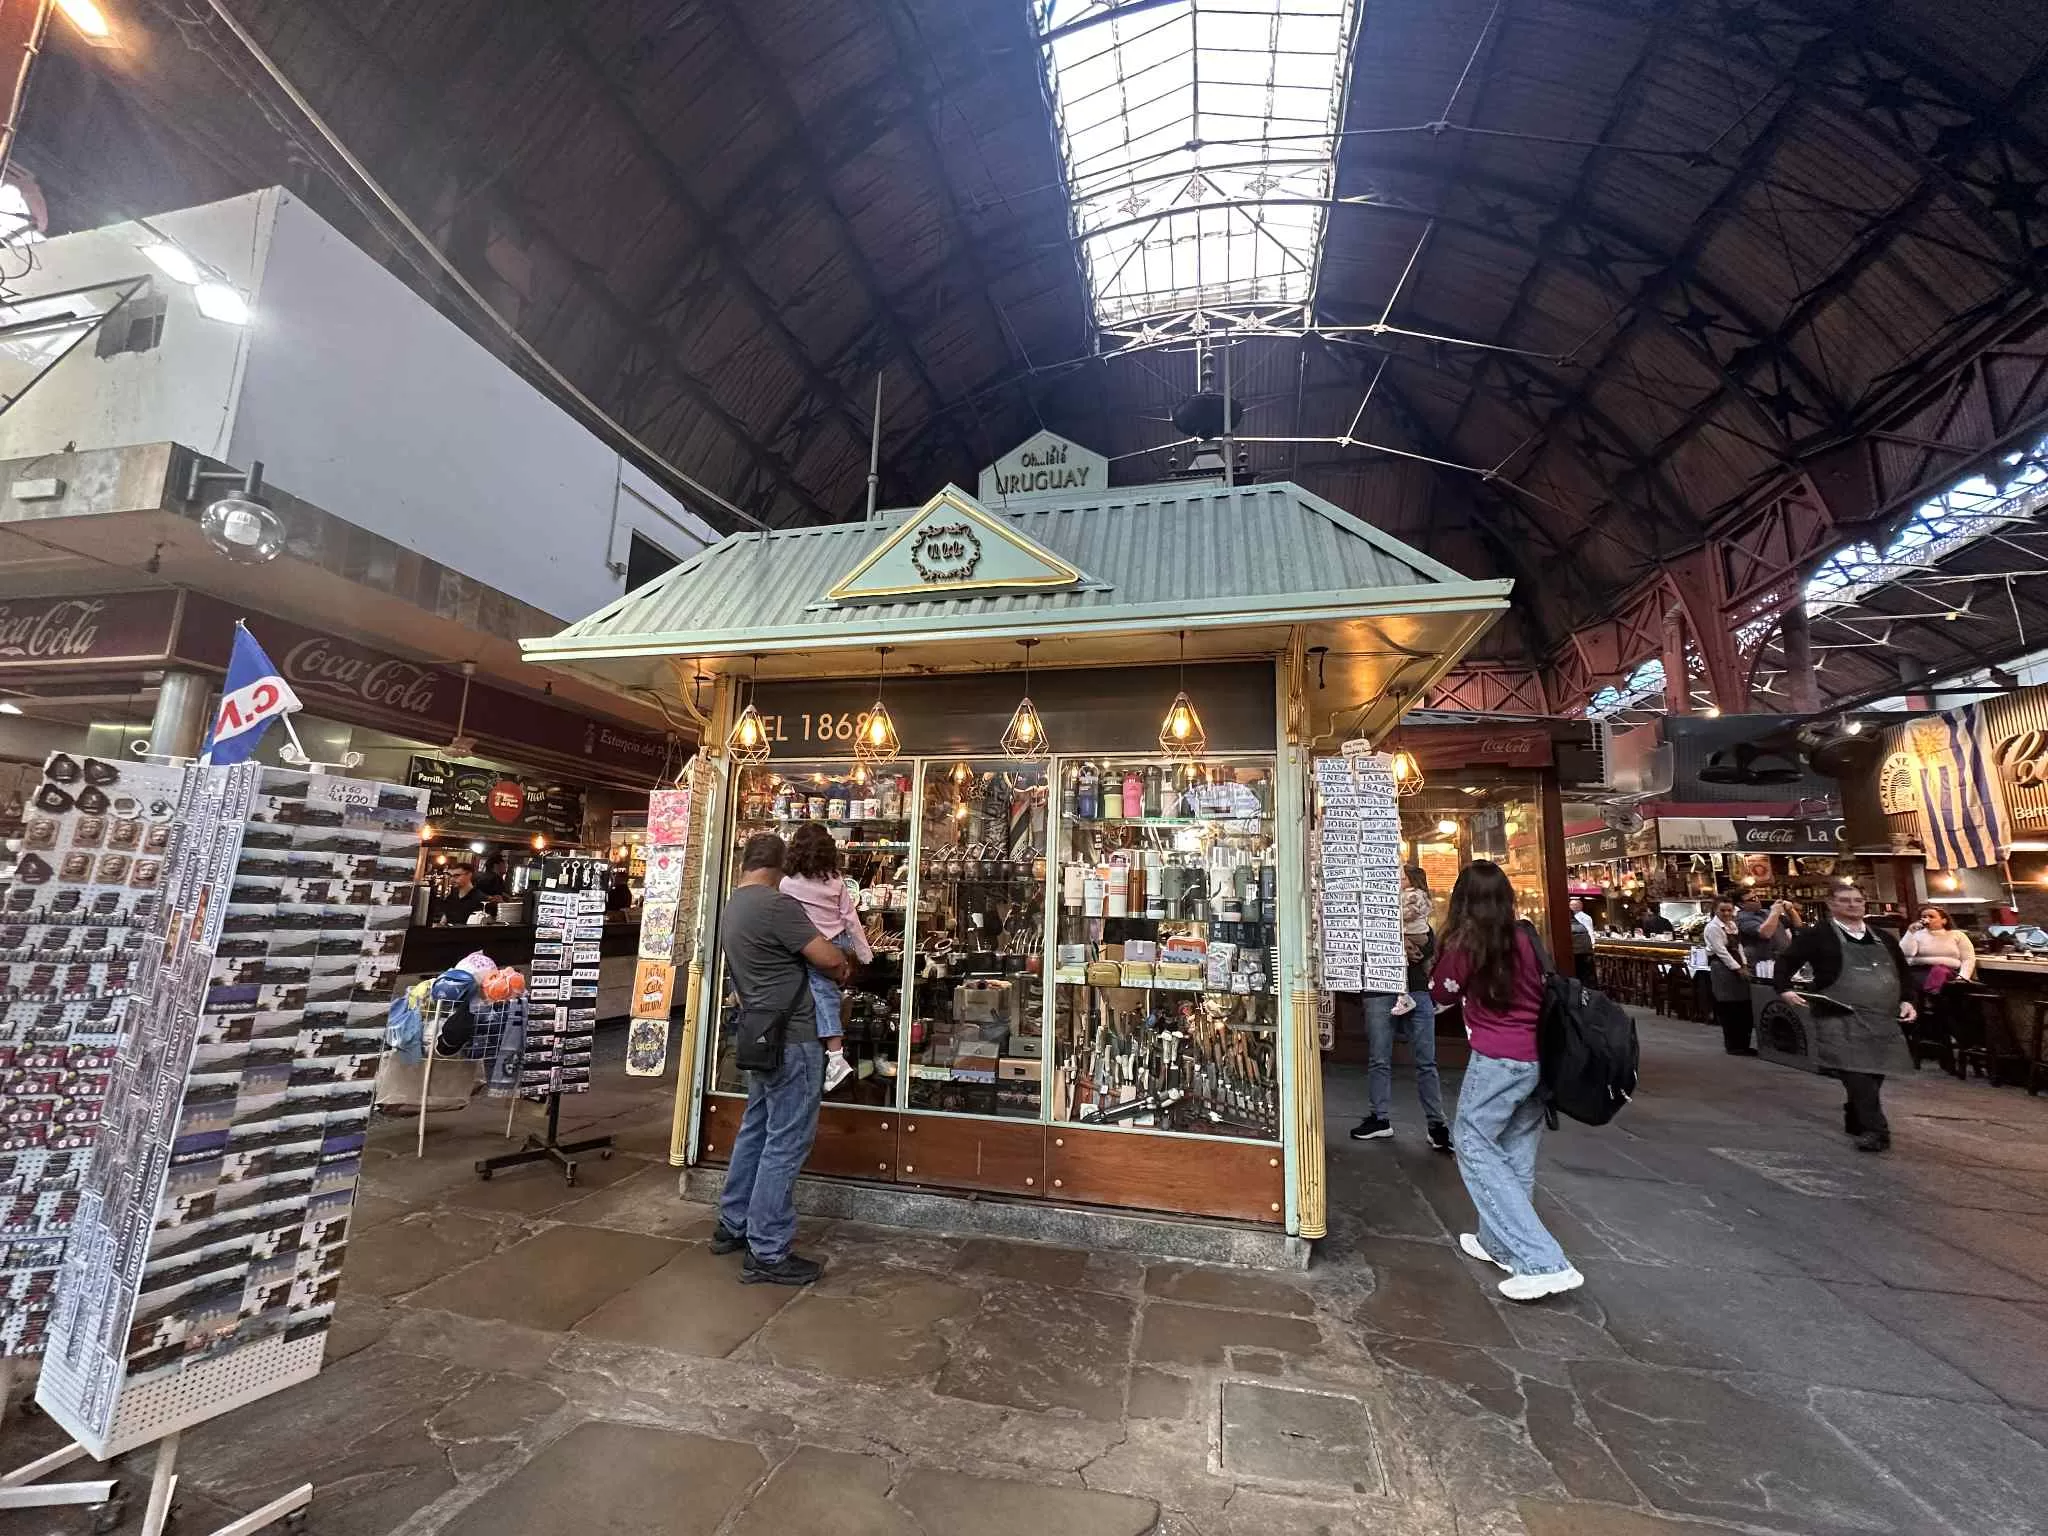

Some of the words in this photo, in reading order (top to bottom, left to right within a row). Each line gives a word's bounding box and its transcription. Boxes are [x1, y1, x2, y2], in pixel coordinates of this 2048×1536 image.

[996, 467, 1090, 495] URUGUAY
[283, 638, 439, 713] Coca-Cola
[418, 772, 444, 785] Parrilla
[1362, 784, 1393, 795] ISAAC
[346, 794, 369, 805] 200
[455, 803, 472, 812] Paella
[1327, 820, 1358, 828] JORGE
[1746, 828, 1795, 843] Coca-Cola
[1806, 825, 1829, 842] La
[219, 826, 237, 884] URUGUAY
[1363, 847, 1394, 855] JAZMIN
[1364, 857, 1396, 865] JUANA
[1365, 882, 1397, 891] JIMENA
[204, 886, 225, 939] URUGUAY
[1366, 907, 1398, 916] KEVIN
[1365, 921, 1397, 929] LEONEL
[1329, 931, 1358, 940] LARA
[1365, 931, 1398, 940] LEANDRO
[1367, 943, 1400, 953] LUCIANO
[1327, 957, 1359, 965] LEONOR
[561, 977, 569, 999] PUNTA
[127, 1219, 147, 1282] URUGUAY
